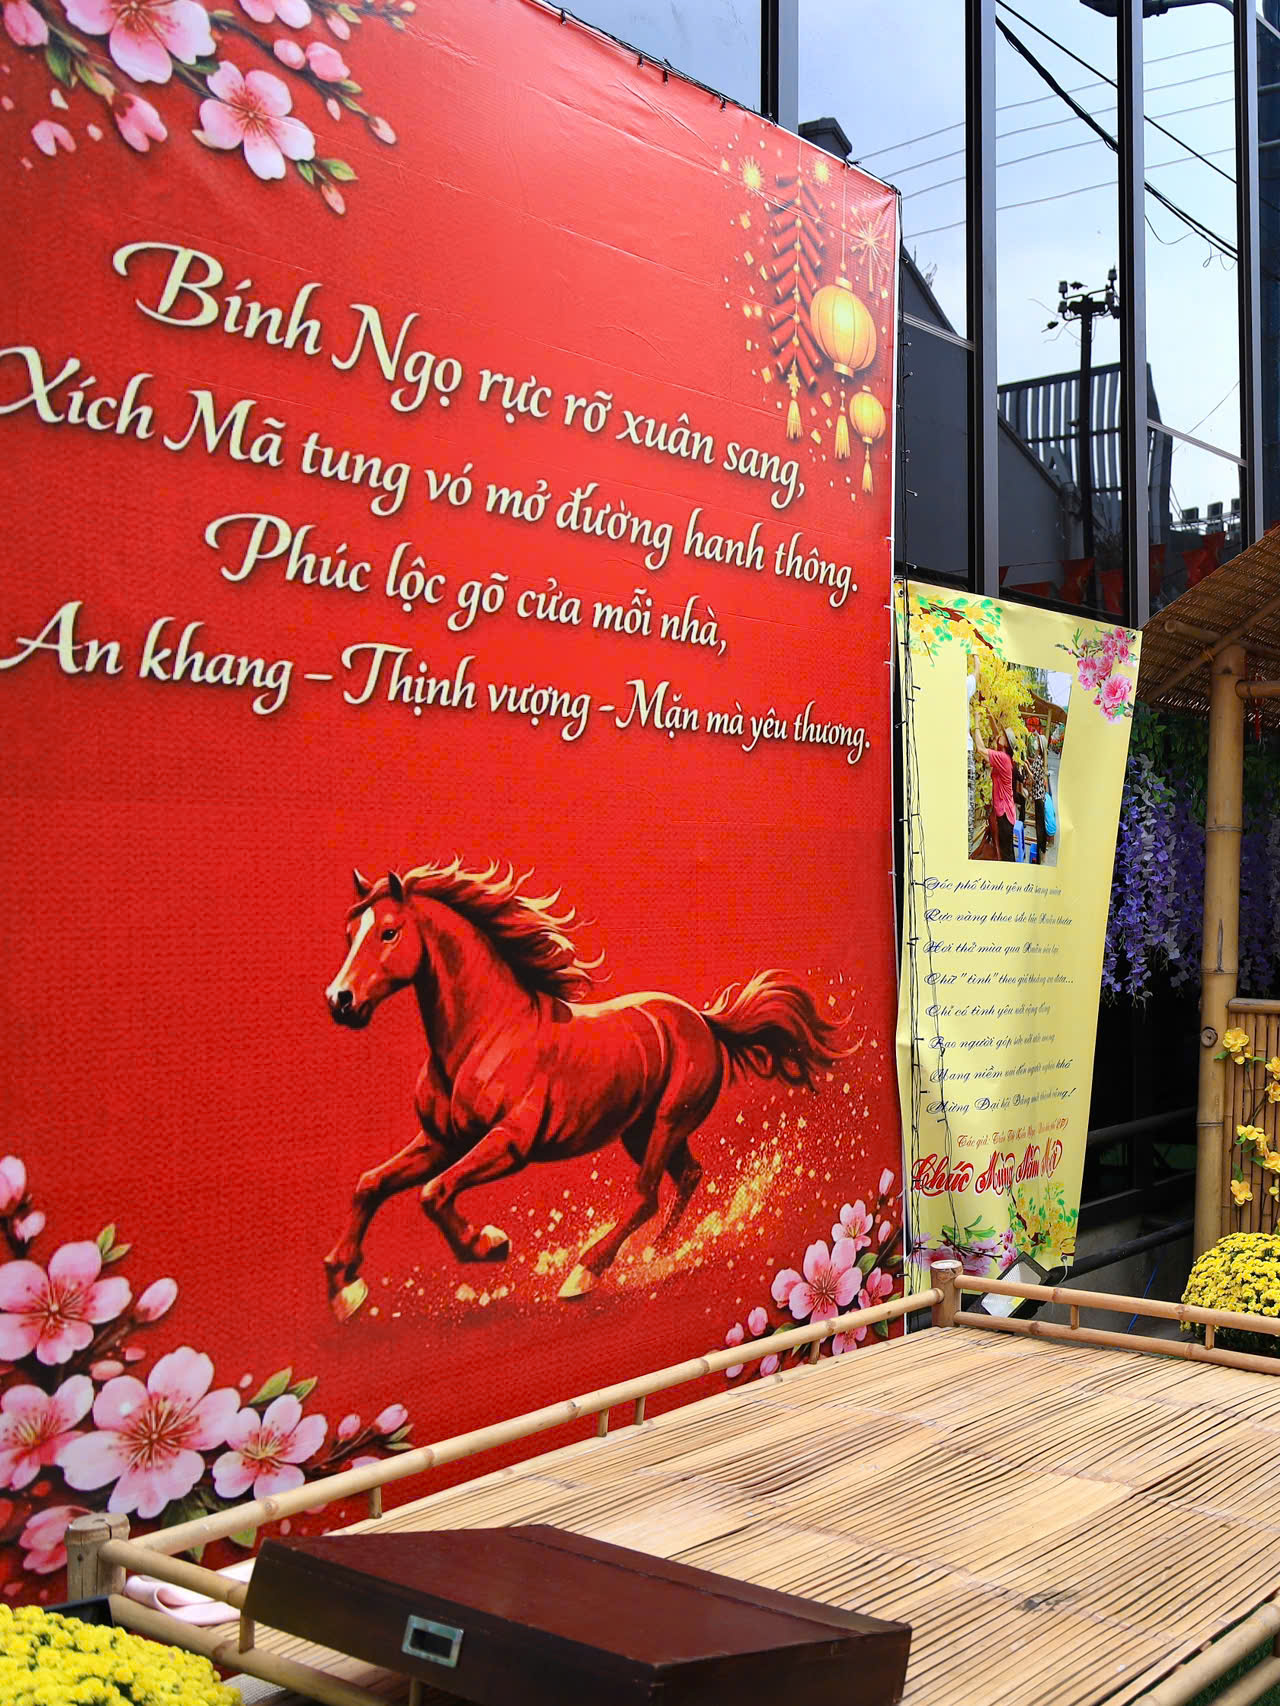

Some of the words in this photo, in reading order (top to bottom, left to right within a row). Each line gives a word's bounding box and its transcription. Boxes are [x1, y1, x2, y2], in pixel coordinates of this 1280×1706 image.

[113, 242, 322, 356] Bính
[332, 304, 462, 411] Ngọ
[479, 368, 552, 423] rực
[563, 391, 612, 432] rỡ
[617, 415, 714, 464] xuân
[724, 441, 806, 508] sang,
[0, 346, 154, 439] Xích
[163, 391, 284, 465] Mã
[302, 433, 409, 516] tung
[425, 463, 473, 506] vó
[486, 480, 551, 521] mở
[556, 482, 673, 570] đường
[684, 508, 765, 570] hanh
[775, 533, 858, 607] thông.
[205, 514, 371, 592] Phúc
[386, 542, 445, 612] lộc
[447, 573, 506, 631] gõ
[517, 578, 581, 625] cửa
[592, 588, 652, 635] mỗi
[661, 596, 727, 655] nhà,
[0, 601, 123, 674] An
[140, 617, 293, 714] khang
[342, 642, 478, 715] Thịnh
[488, 684, 591, 740] vượng
[616, 680, 699, 737] Mặn
[707, 702, 743, 735] mà
[742, 708, 788, 750] yêu
[794, 701, 871, 764] thương.
[954, 878, 982, 893] phố
[980, 880, 1003, 891] bình
[1006, 882, 1021, 894] yên
[990, 912, 1013, 921] khoe
[956, 942, 976, 952] thở
[978, 943, 1002, 952] mùa
[1004, 946, 1020, 956] qua
[924, 972, 957, 984] Chữ
[999, 973, 1016, 984] theo
[926, 1005, 953, 1016] Chỉ
[955, 1005, 969, 1016] có
[971, 1005, 995, 1016] tình
[997, 1004, 1013, 1018] yêu
[960, 1036, 995, 1051] người
[996, 1036, 1012, 1049] góp
[930, 1069, 970, 1082] Mang
[974, 1066, 1002, 1079] niềm
[1056, 1059, 1073, 1069] khó
[926, 1100, 970, 1115] Mừng
[975, 1097, 1000, 1112] Đại
[957, 1134, 975, 1148] Tác
[912, 1153, 974, 1196] Chúc
[975, 1150, 1016, 1196] Mừng
[1016, 1143, 1040, 1183] Năm
